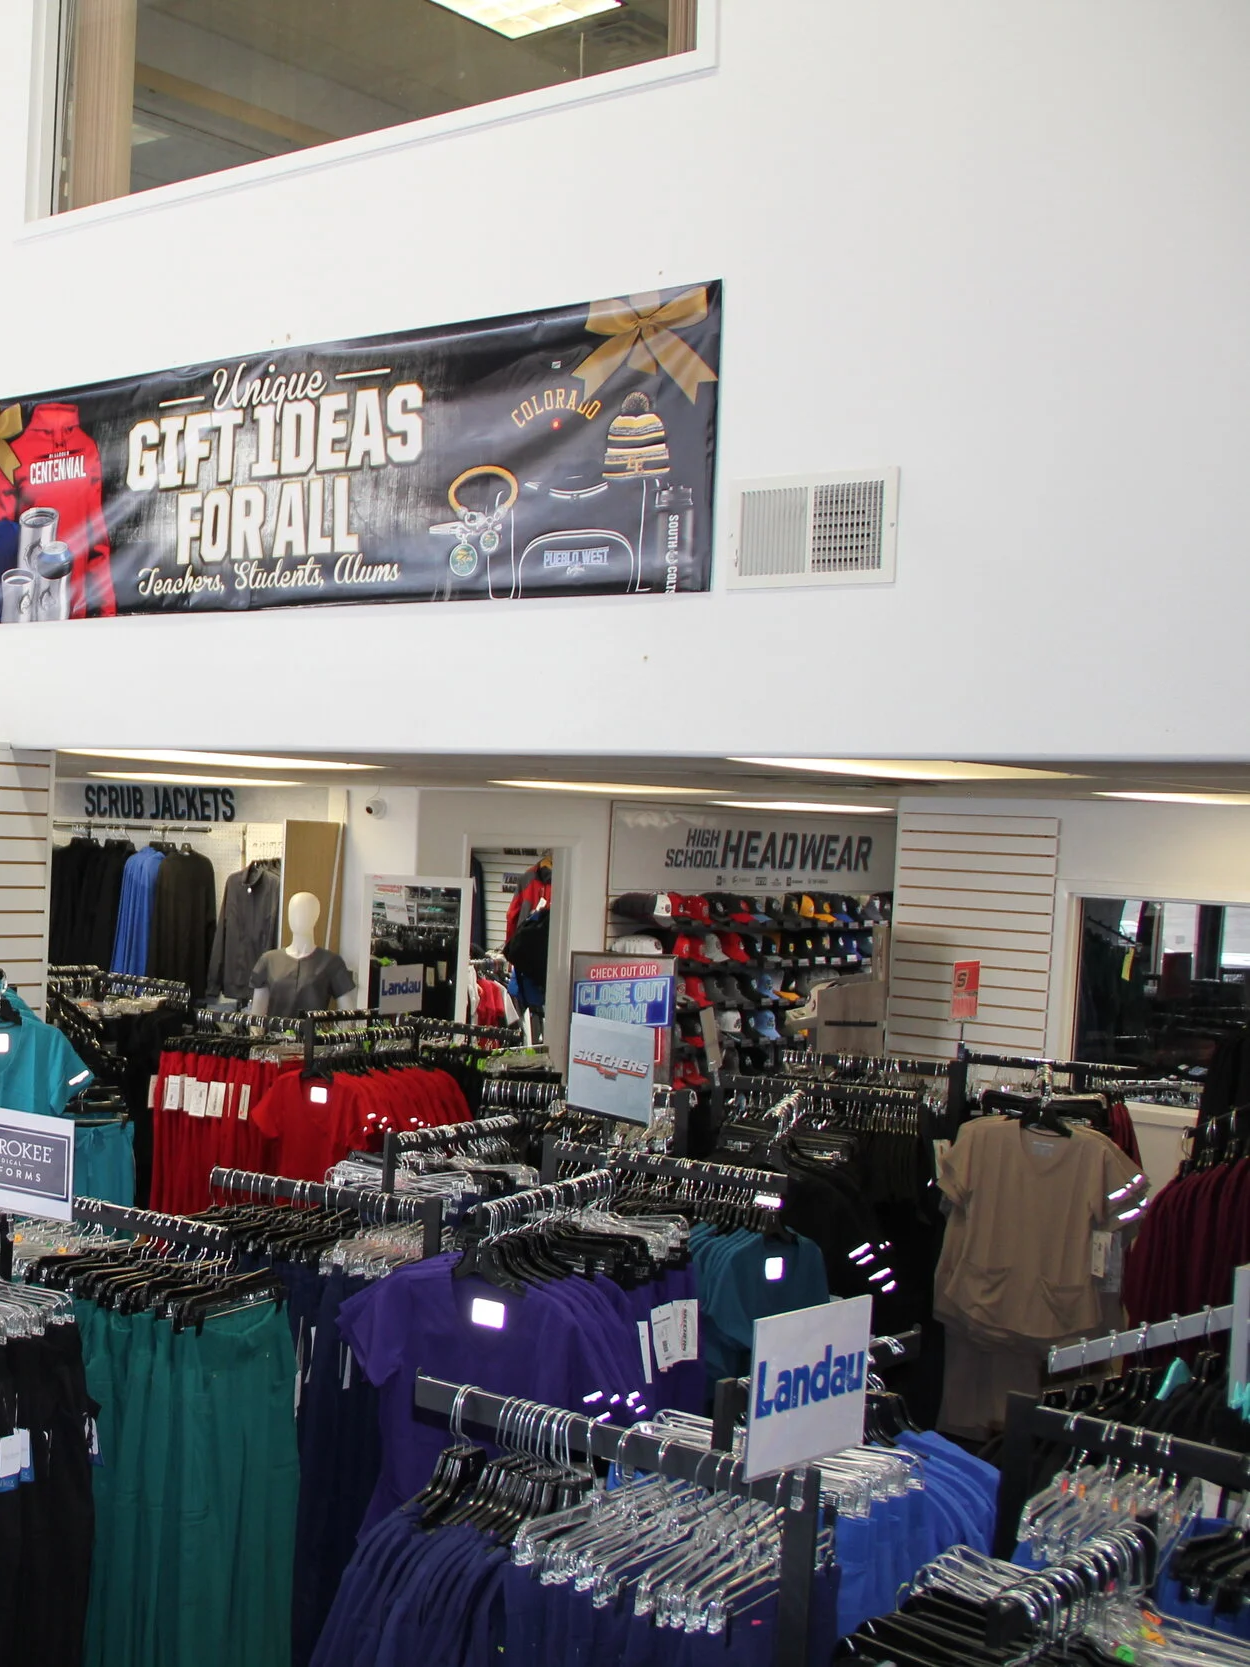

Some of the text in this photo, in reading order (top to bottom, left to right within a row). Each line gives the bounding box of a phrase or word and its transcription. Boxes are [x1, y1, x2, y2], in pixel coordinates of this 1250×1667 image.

[212, 363, 328, 423] Unique
[511, 388, 602, 428] COLORADO
[126, 382, 425, 492] GIFT IDEAS
[30, 455, 87, 485] CENTENNIAL
[176, 475, 360, 565] FOR ALL
[544, 548, 609, 568] PUEBLO WEST
[665, 514, 679, 594] SOUTH COLTS
[138, 553, 400, 596] Teachers, Students, Alums
[84, 784, 235, 822] SCRUB JACKETS
[664, 829, 873, 872] SCHOOL HEADWEAR
[686, 828, 721, 847] HIGH
[381, 977, 421, 996] Landau
[590, 964, 657, 979] CHECK OUT OUR
[579, 980, 666, 1006] CLOSE OUT
[595, 1002, 647, 1024] ROOM!
[573, 1049, 649, 1074] SKECHERS
[754, 1344, 868, 1419] Landau
